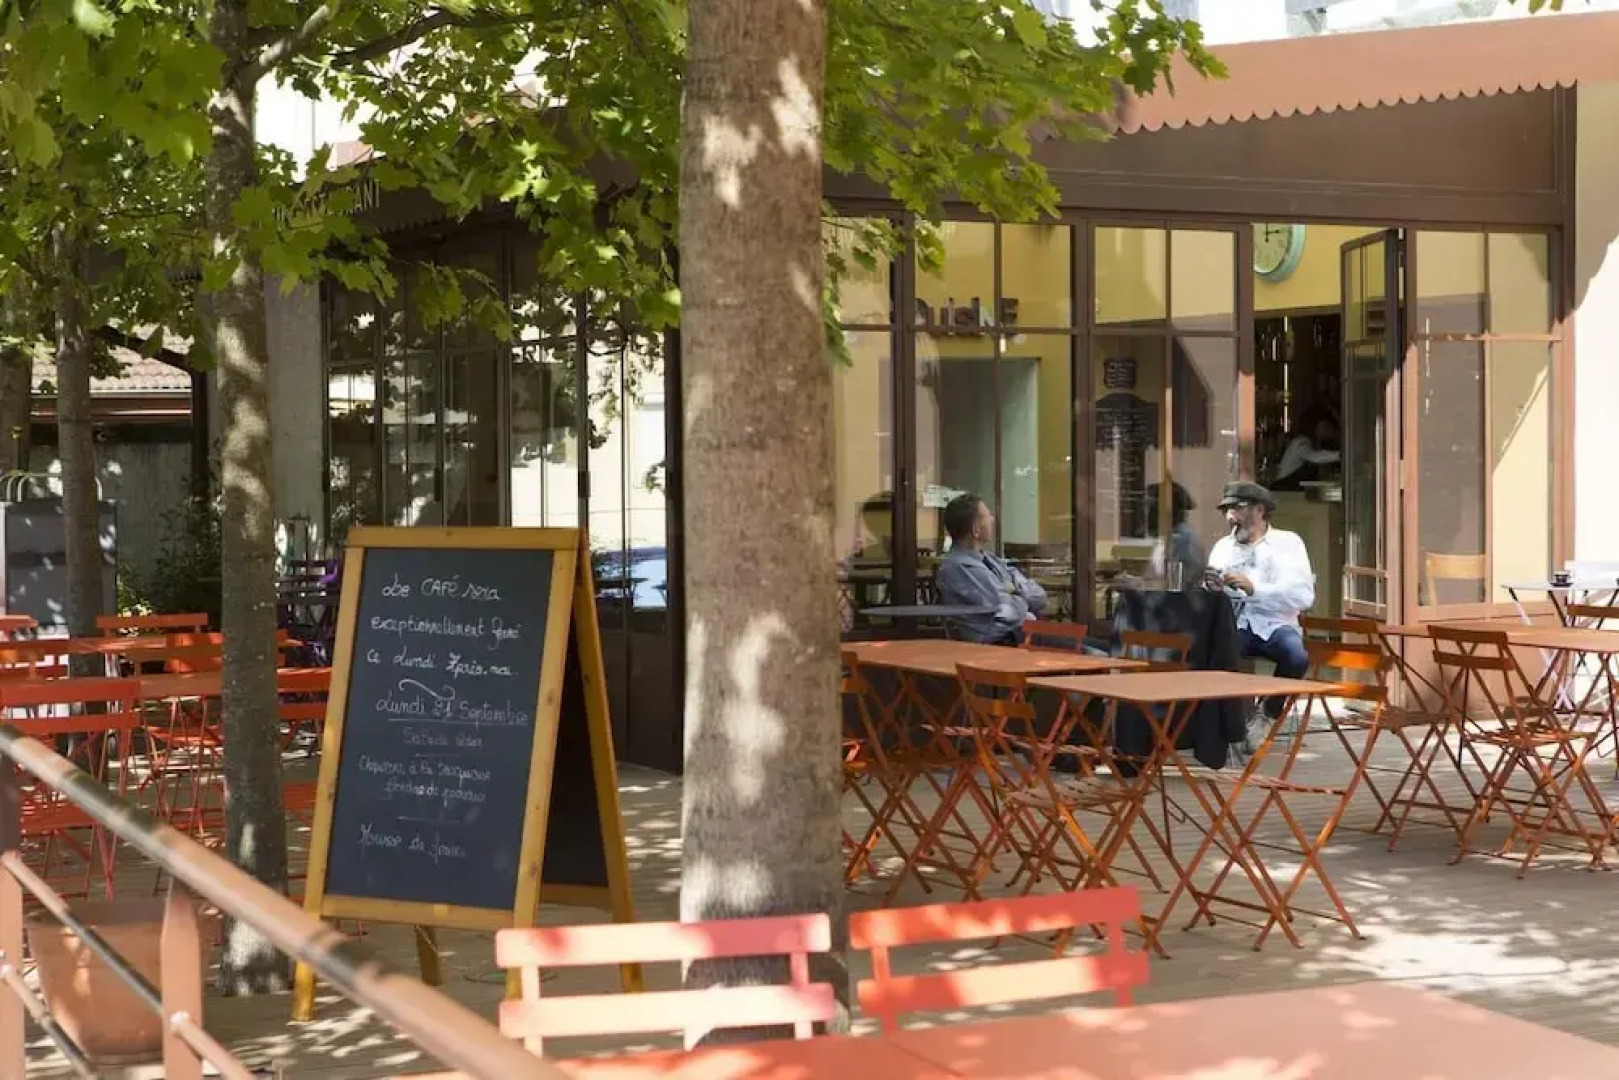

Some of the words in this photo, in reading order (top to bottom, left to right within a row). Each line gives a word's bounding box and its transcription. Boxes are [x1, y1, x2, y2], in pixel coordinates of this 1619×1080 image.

[420, 573, 460, 598] CAFÉ
[375, 689, 426, 716] Lundi
[459, 699, 530, 730] Septembre
